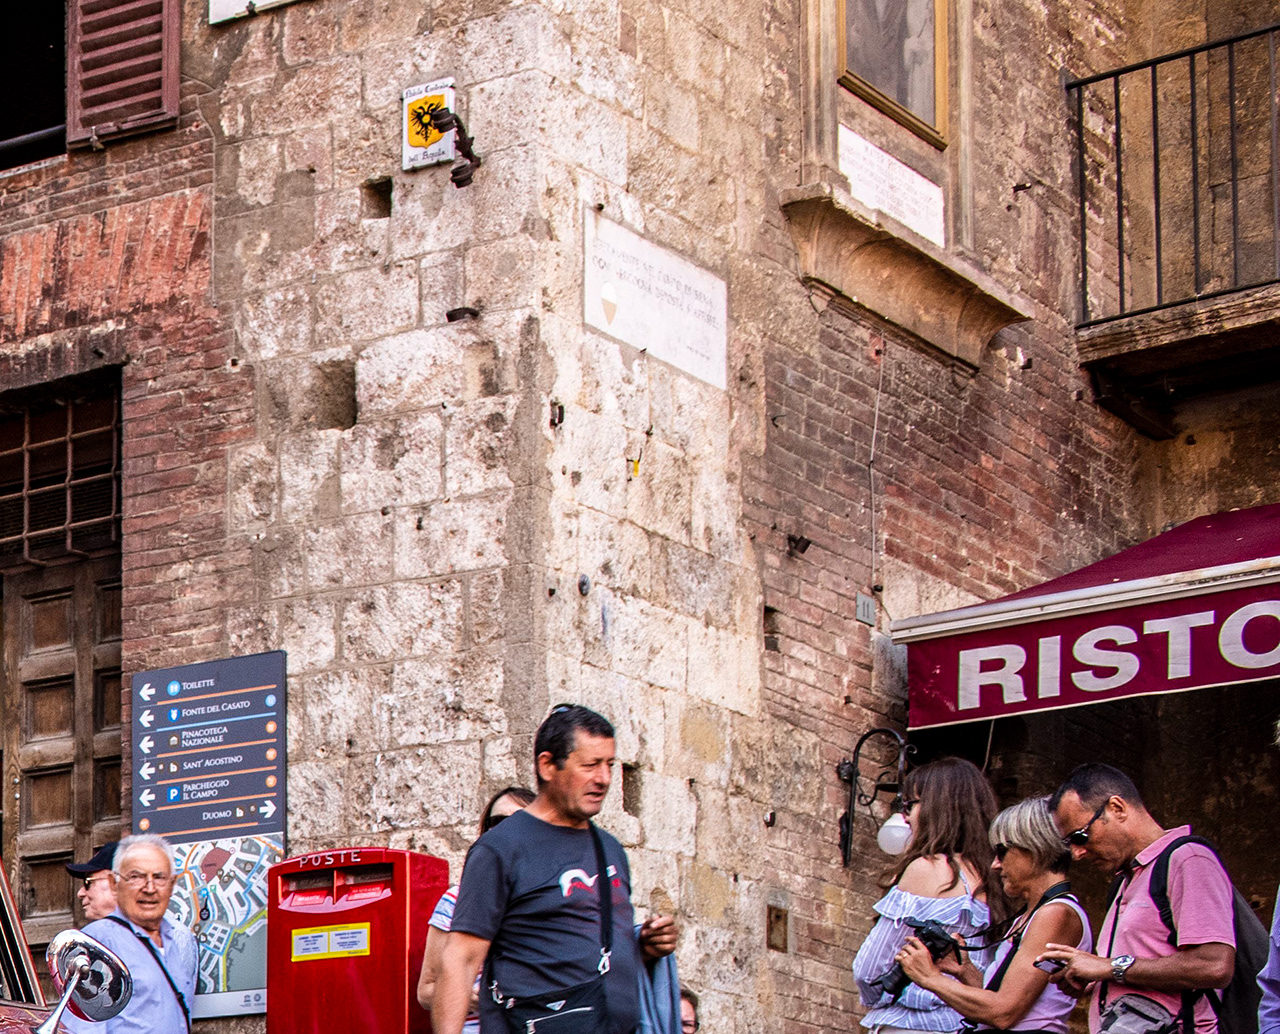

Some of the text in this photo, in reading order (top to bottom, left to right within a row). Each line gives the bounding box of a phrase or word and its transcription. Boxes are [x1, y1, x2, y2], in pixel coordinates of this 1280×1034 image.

[958, 600, 1280, 711] RISTO
[183, 779, 230, 792] PARCHEGGIO
[191, 789, 218, 799] CAMPO
[202, 810, 232, 820] DUOMO
[299, 850, 362, 868] POSTE
